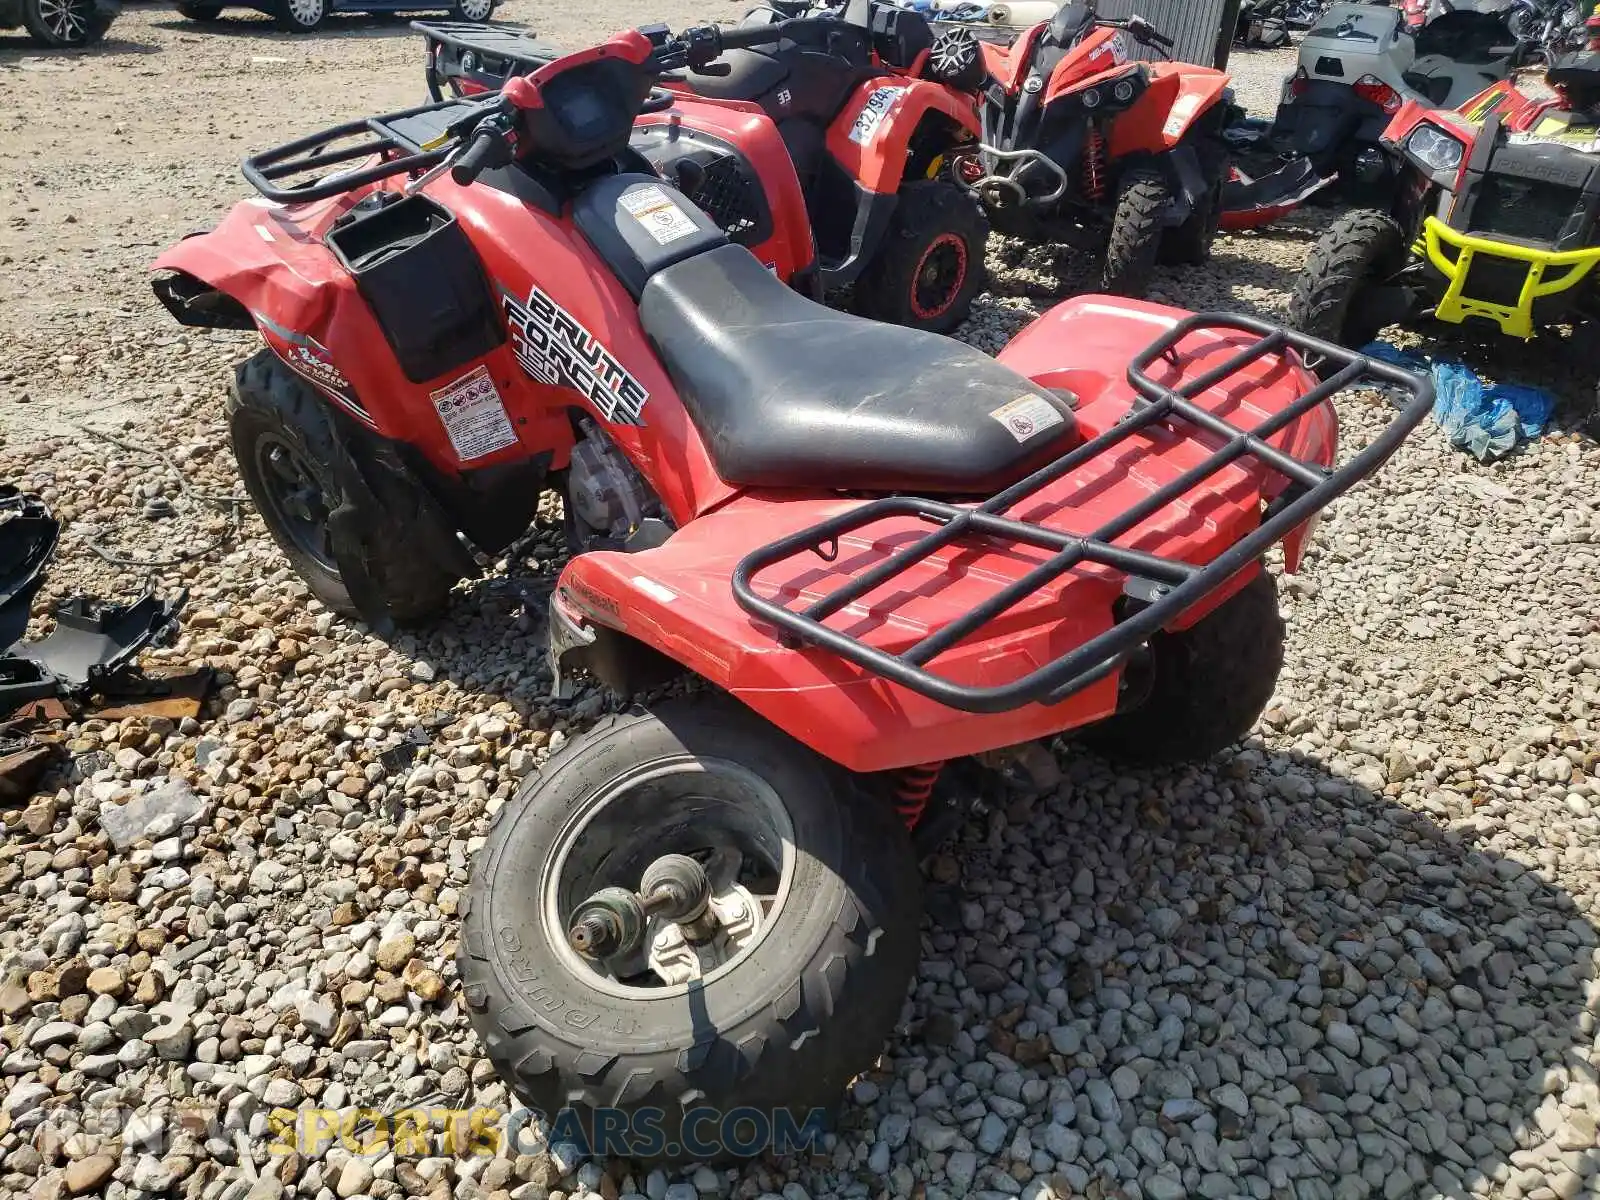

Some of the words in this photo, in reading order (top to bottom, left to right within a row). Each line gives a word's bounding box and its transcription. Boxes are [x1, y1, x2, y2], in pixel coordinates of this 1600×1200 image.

[503, 295, 617, 421] FORCE
[512, 332, 560, 384] 750
[527, 285, 649, 418] BRUTE
